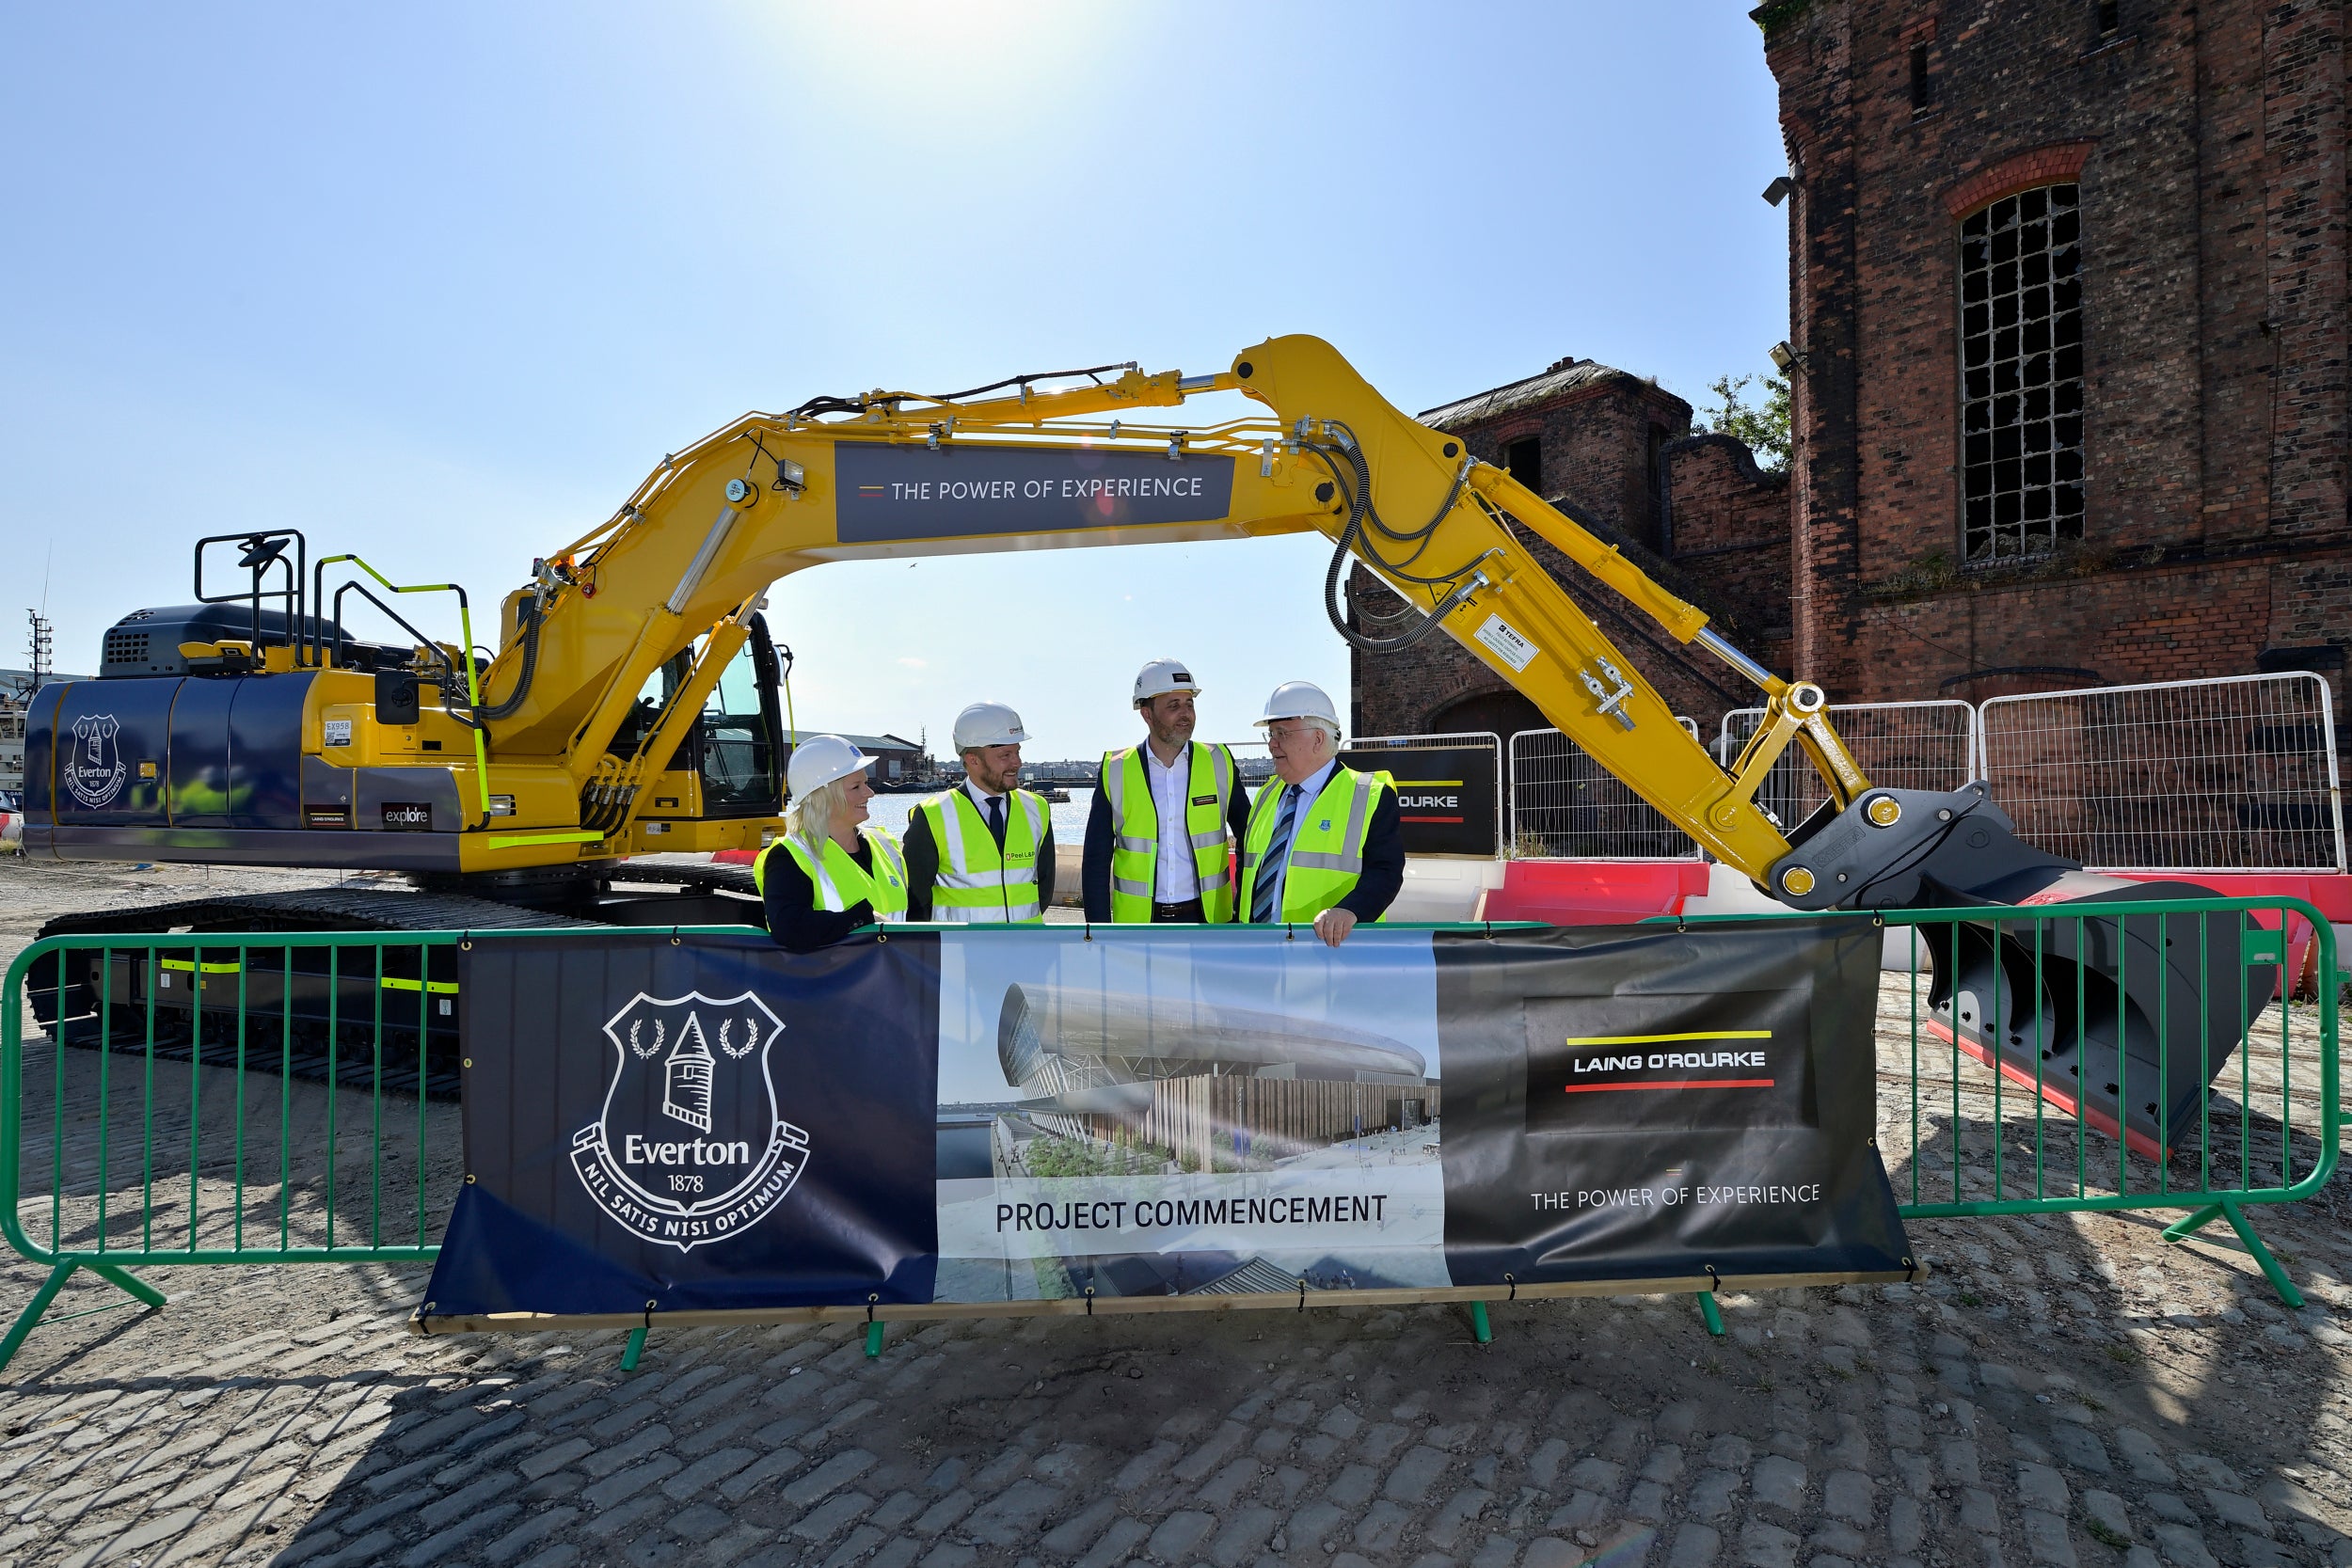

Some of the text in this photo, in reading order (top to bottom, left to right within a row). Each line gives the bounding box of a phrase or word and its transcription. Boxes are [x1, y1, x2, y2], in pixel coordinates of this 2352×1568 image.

[892, 477, 1203, 500] THE POWER OF EXPERIENCE
[1505, 630, 1524, 648] TEFRA
[326, 722, 350, 731] EX958
[78, 766, 111, 778] Everton
[67, 776, 75, 790] NIL
[74, 788, 88, 803] SATIS
[102, 776, 122, 801] OPTIMUM
[1398, 796, 1458, 808] OURKE
[1574, 1051, 1766, 1073] LAING O'ROURKE
[625, 1134, 749, 1165] Everton
[667, 1175, 704, 1193] 1878
[584, 1161, 795, 1237] NIL SATIS NISI OPTIMUM
[1531, 1183, 1821, 1211] THE POWER OF EXPERIENCE
[996, 1194, 1388, 1233] PROJECT COMMENCEMENT
